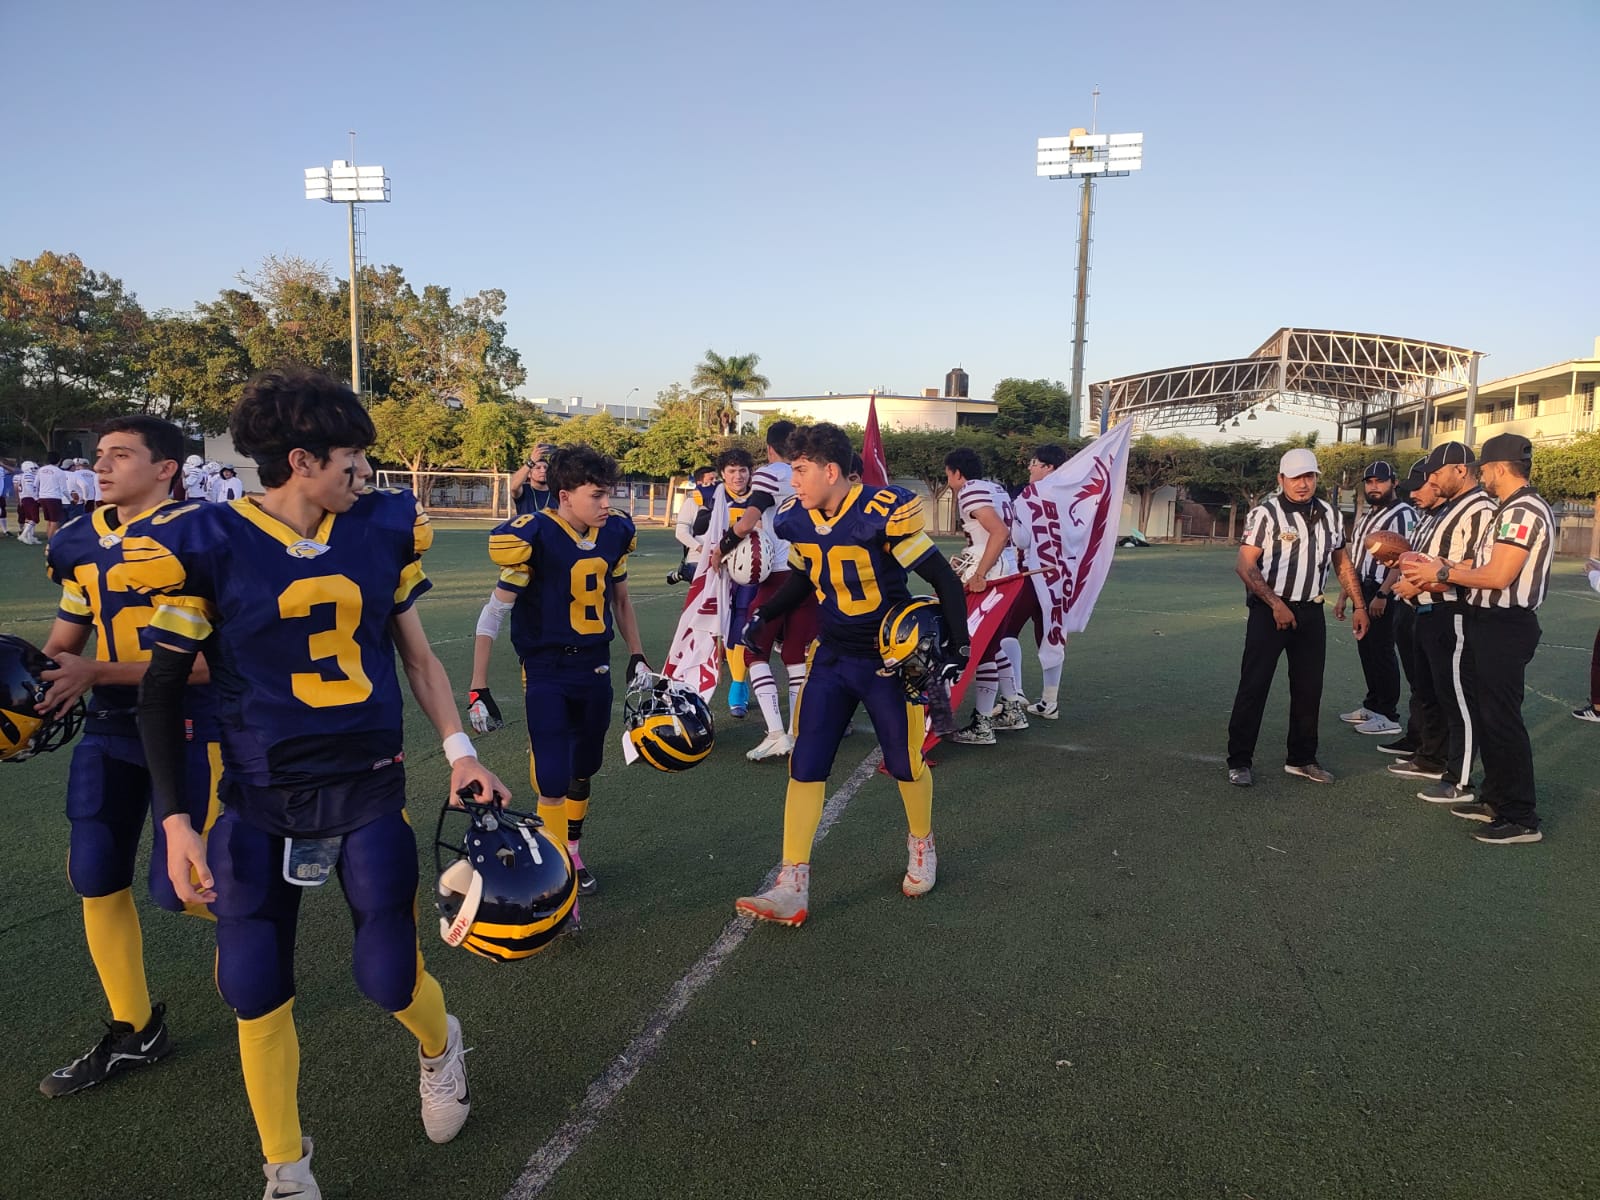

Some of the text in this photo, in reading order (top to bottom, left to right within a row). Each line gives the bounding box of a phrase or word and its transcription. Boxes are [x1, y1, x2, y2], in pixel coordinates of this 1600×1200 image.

[510, 513, 536, 529] 8
[777, 494, 800, 516] 0
[863, 489, 898, 518] 70
[569, 556, 609, 636] 8
[793, 542, 883, 617] 70
[277, 573, 374, 709] 3
